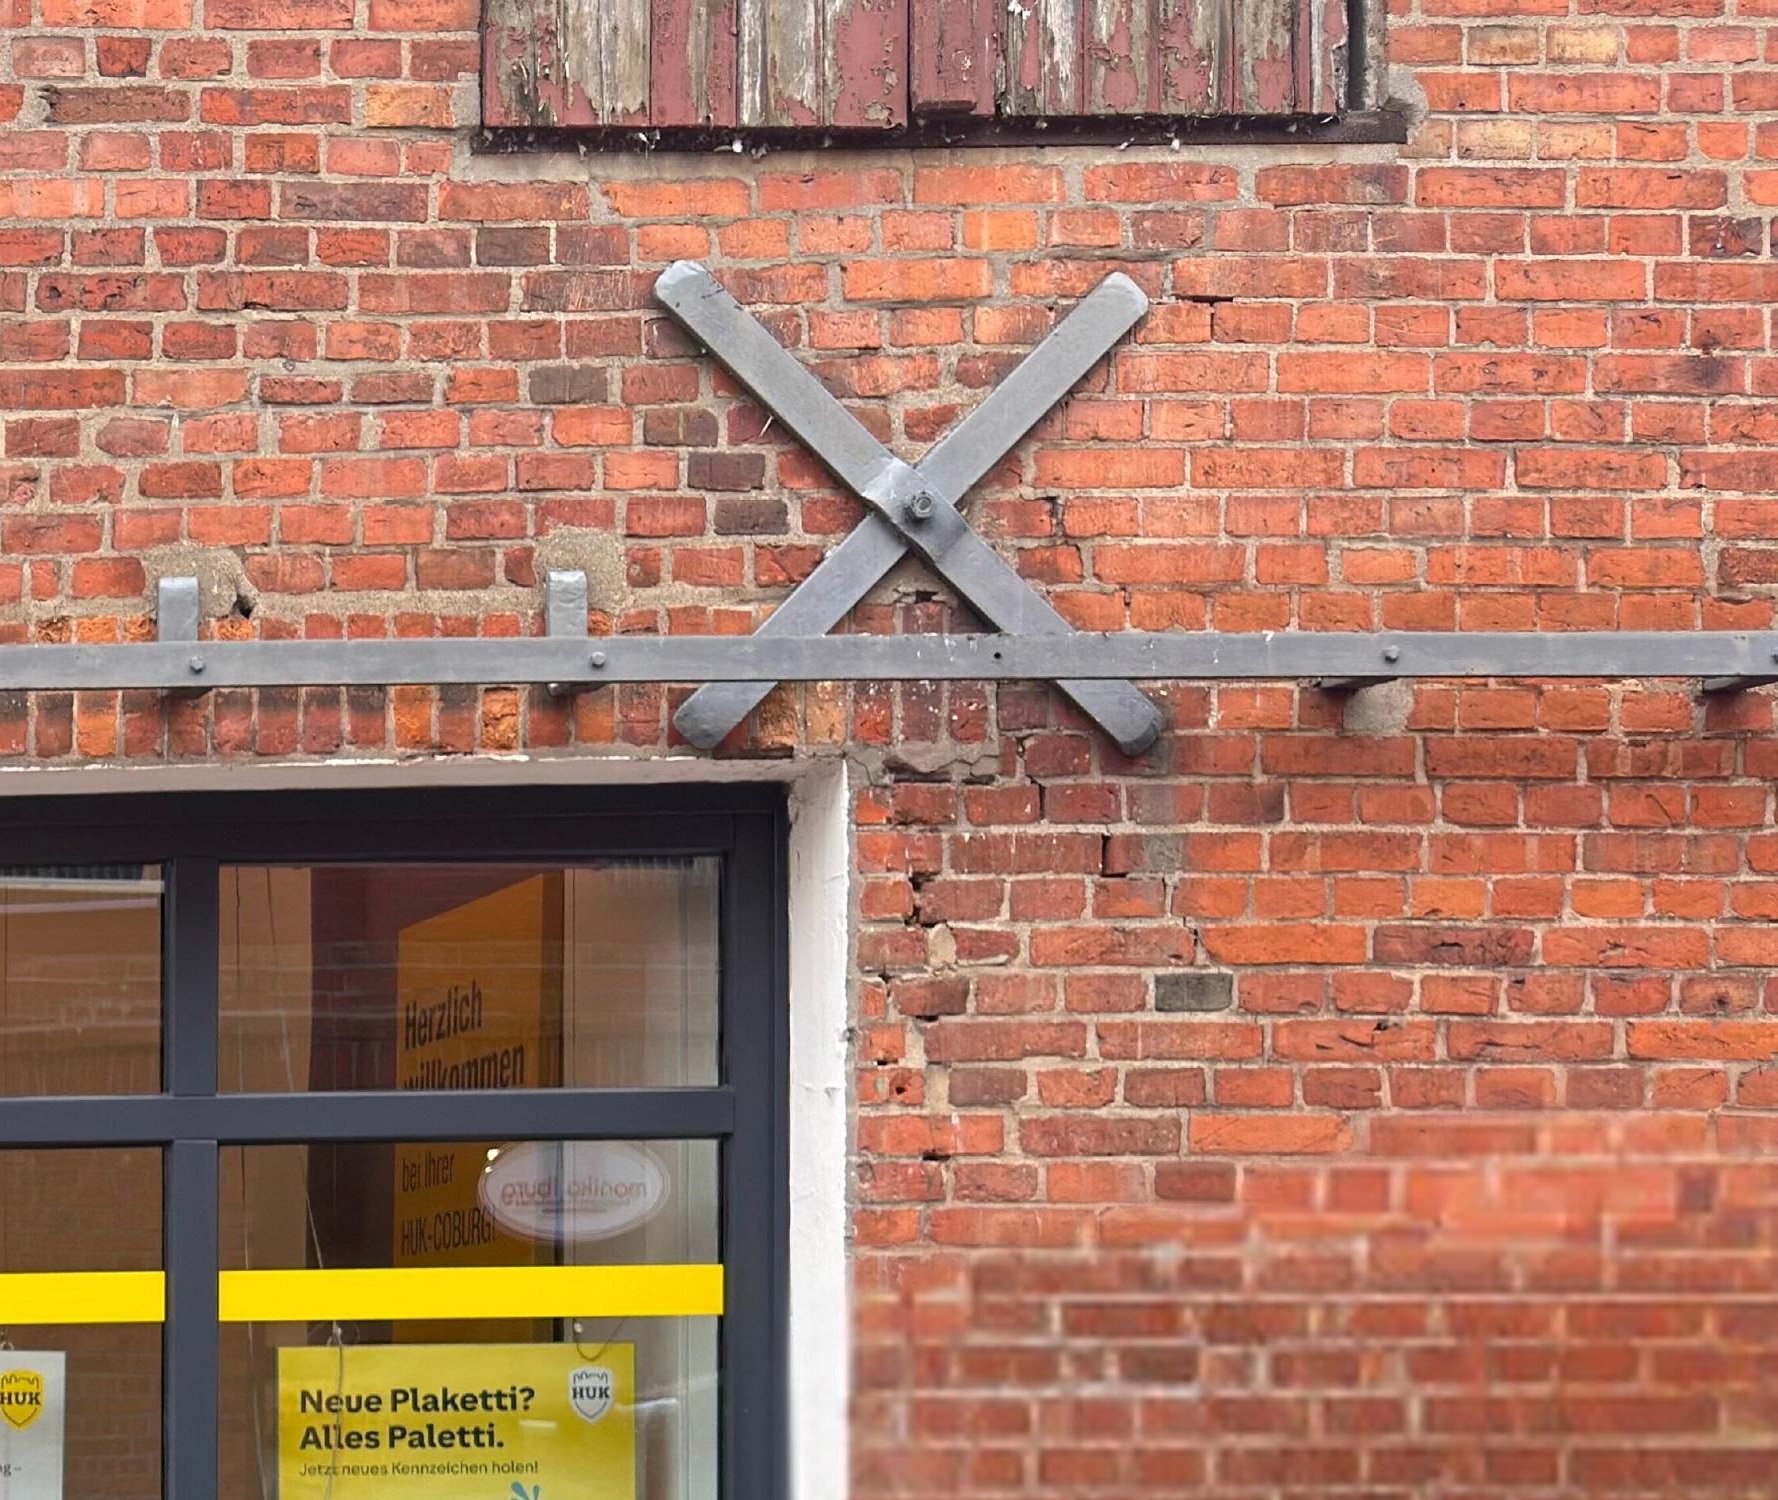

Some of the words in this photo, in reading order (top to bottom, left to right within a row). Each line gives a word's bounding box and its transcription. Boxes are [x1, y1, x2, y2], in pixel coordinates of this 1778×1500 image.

[404, 981, 483, 1050] Herzlich
[404, 1044, 525, 1089] willkommen
[402, 1160, 420, 1192] bei
[424, 1151, 455, 1188] Ihrer
[0, 1392, 41, 1406] HUK
[300, 1389, 383, 1412] Neue
[391, 1386, 535, 1412] Plaketti?
[572, 1386, 610, 1399] HUK
[300, 1425, 380, 1450] Alles
[388, 1424, 504, 1449] Paletti.
[342, 1464, 388, 1475] neues
[392, 1462, 488, 1475] Kennzeichen
[492, 1461, 538, 1474] holen!
